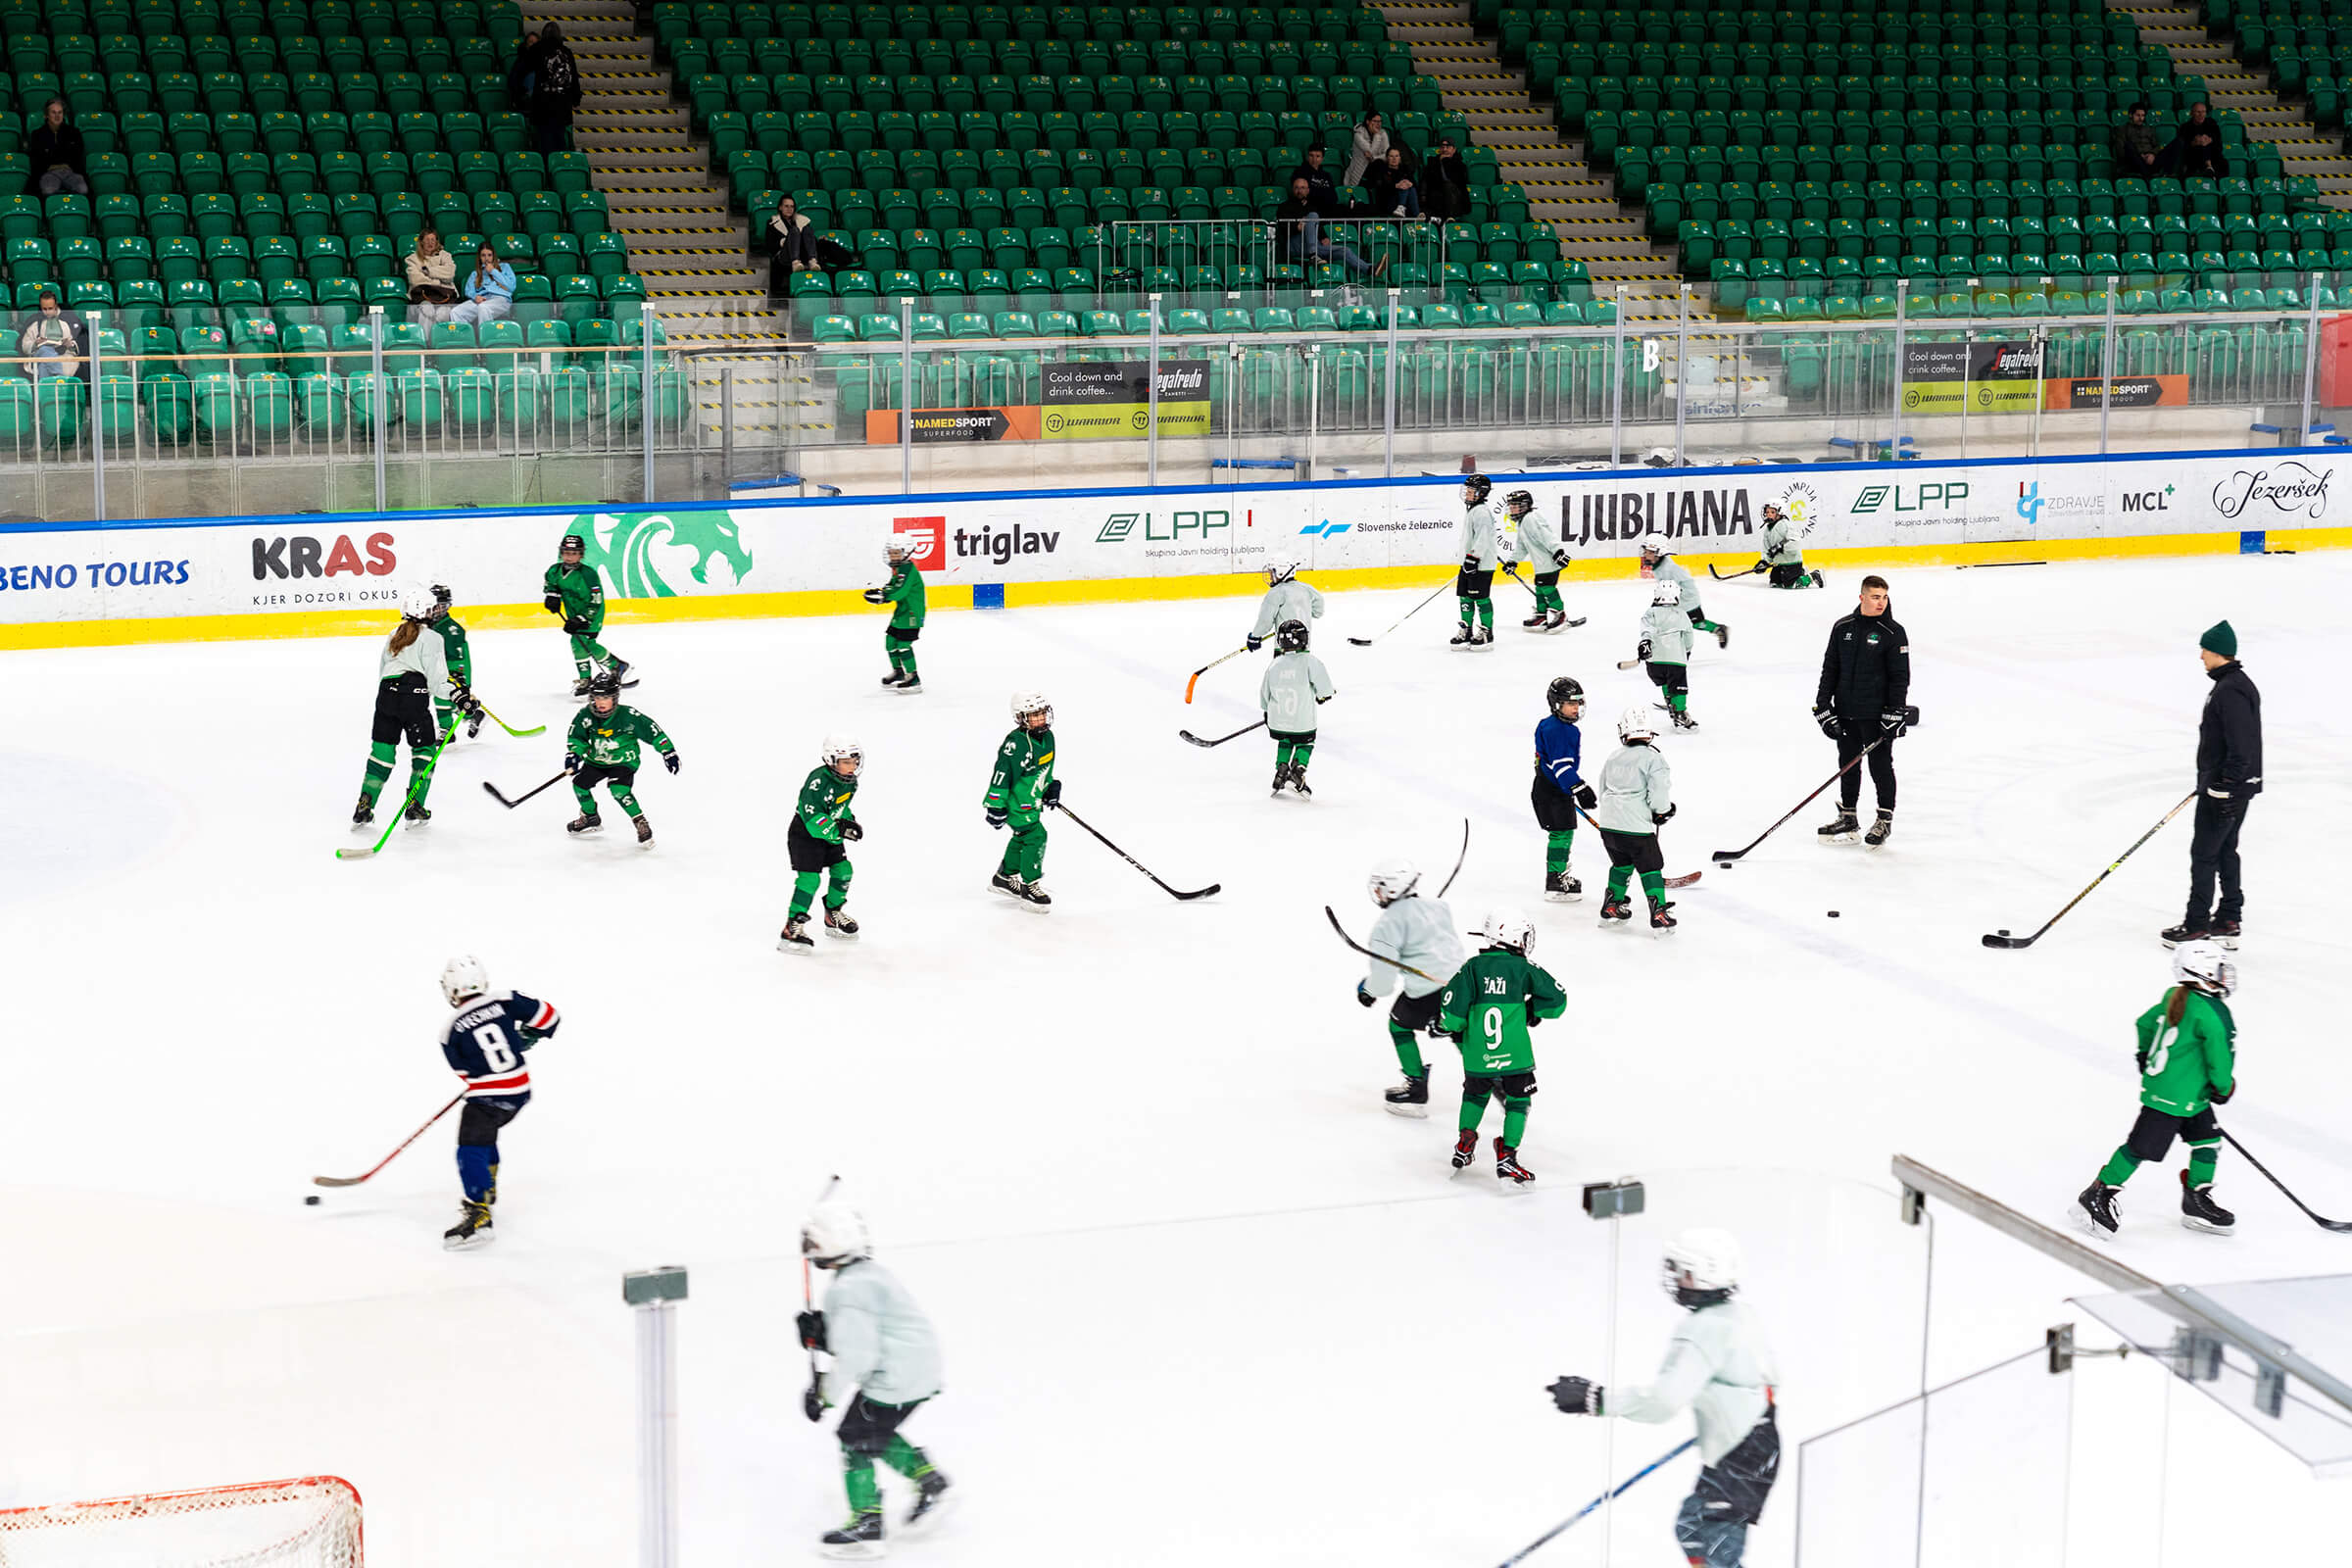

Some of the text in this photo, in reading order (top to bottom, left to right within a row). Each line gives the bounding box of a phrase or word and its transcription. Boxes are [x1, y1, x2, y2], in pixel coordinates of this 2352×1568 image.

[1909, 351, 1929, 362] Cool
[1931, 351, 1953, 361] down
[1049, 370, 1123, 383] Cool down and
[1146, 368, 1202, 392] egafredo
[1049, 386, 1074, 397] drink
[1066, 416, 1121, 426] WARRIOR
[1894, 482, 1969, 512] LPP
[2213, 461, 2334, 519] Jezeršek
[2047, 495, 2105, 510] ZDRAVJE
[1146, 510, 1230, 541] LPP
[1357, 519, 1453, 533] Slovenske železnice
[1561, 488, 1753, 547] LJUBLJANA
[1894, 518, 1922, 527] skupina
[1942, 516, 1968, 526] holding
[1969, 515, 1999, 524] Ljubljana
[954, 523, 1060, 564] triglav
[1145, 548, 1176, 558] skupina
[1200, 547, 1229, 557] holding
[1231, 546, 1265, 555] Ljubljana
[252, 532, 397, 580] KRAS
[86, 560, 190, 588] TOURS
[253, 590, 399, 606] KJER DOZORI OKUS
[993, 770, 1005, 786] 17
[1484, 976, 1506, 995] ŽAŽI
[1442, 990, 1453, 1006] 9
[1483, 1006, 1503, 1051] 9
[472, 1022, 518, 1074] 8
